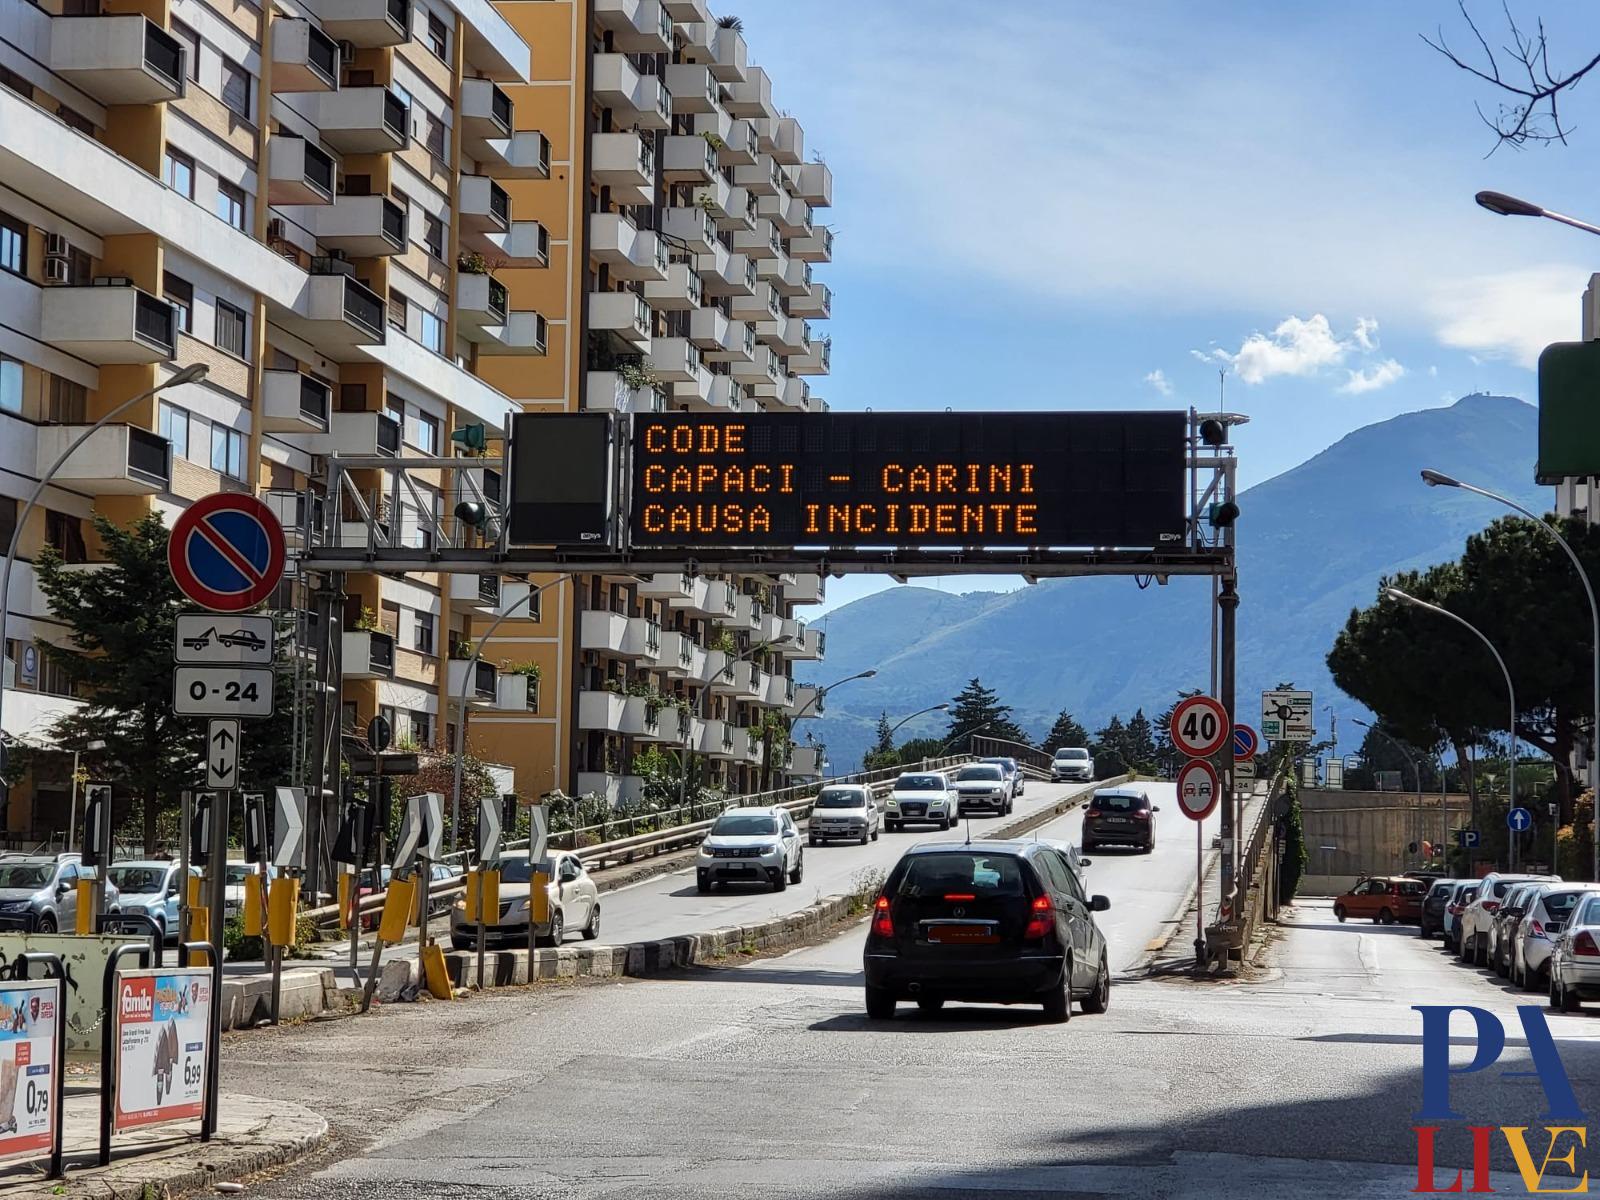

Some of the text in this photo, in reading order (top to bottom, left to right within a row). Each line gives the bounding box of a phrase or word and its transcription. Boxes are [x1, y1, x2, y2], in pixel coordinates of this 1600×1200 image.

[646, 425, 745, 453] CODE
[645, 464, 794, 493] CAPACI
[883, 464, 1035, 493] CARINI
[644, 504, 1038, 533] CAUSA INCIDENTE
[1183, 713, 1217, 741] 40
[1465, 832, 1477, 847] P
[121, 984, 152, 1016] famila
[184, 1056, 202, 1088] 6,99
[26, 1079, 49, 1117] 0,79
